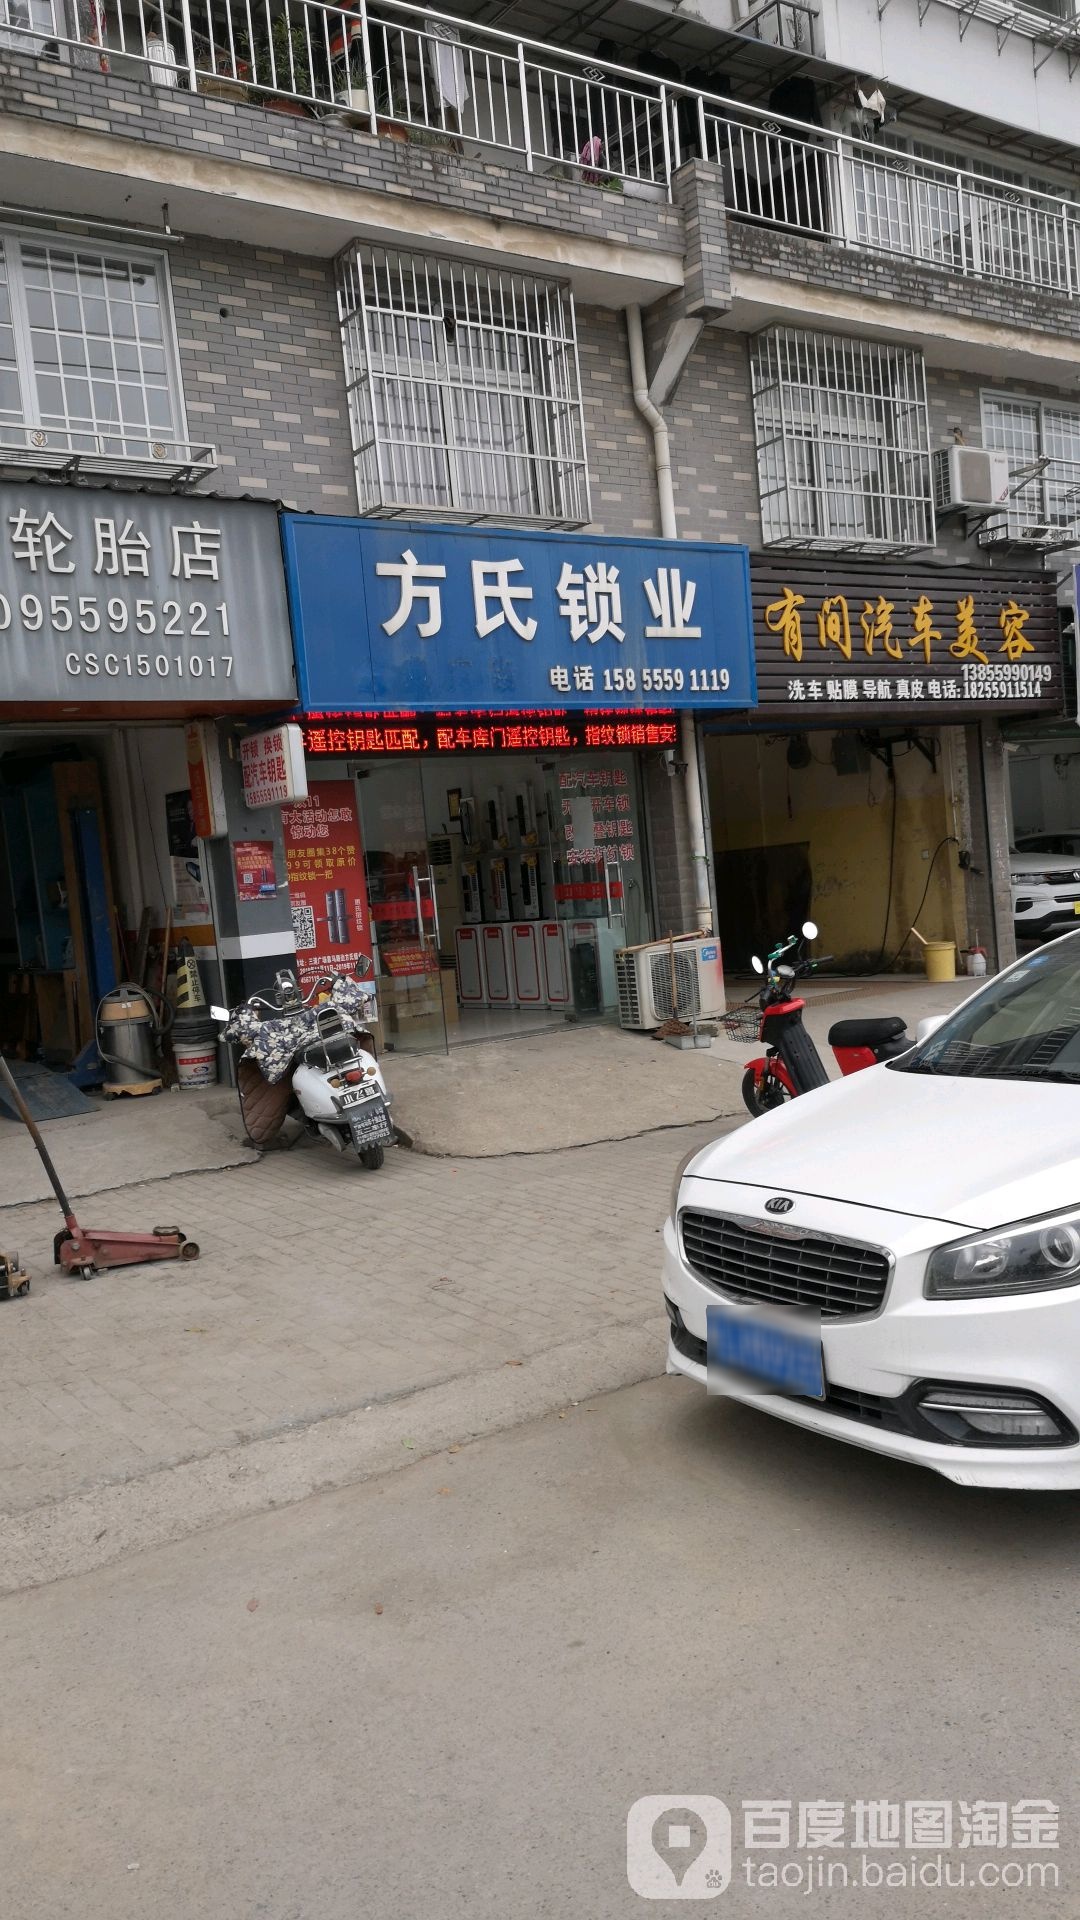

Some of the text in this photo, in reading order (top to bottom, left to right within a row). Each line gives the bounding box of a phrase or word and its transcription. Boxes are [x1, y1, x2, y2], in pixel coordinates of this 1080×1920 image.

[9, 508, 221, 581] 轮胎店
[376, 549, 701, 644] 方氏锁业
[764, 587, 1035, 664] 有间汽车美容
[66, 653, 233, 678] CSC1501017
[961, 664, 1052, 682] 13855990149
[549, 666, 730, 693] 电话 158 5559 1119
[788, 680, 823, 700] 洗车
[826, 680, 858, 700] 贴膜
[862, 680, 892, 700] 导航
[896, 679, 924, 700] 真皮
[242, 740, 259, 760] 开锁
[243, 755, 286, 788] 配汽车钥匙
[559, 769, 628, 789] 配汽车钥匙
[766, 1199, 790, 1211] KIA
